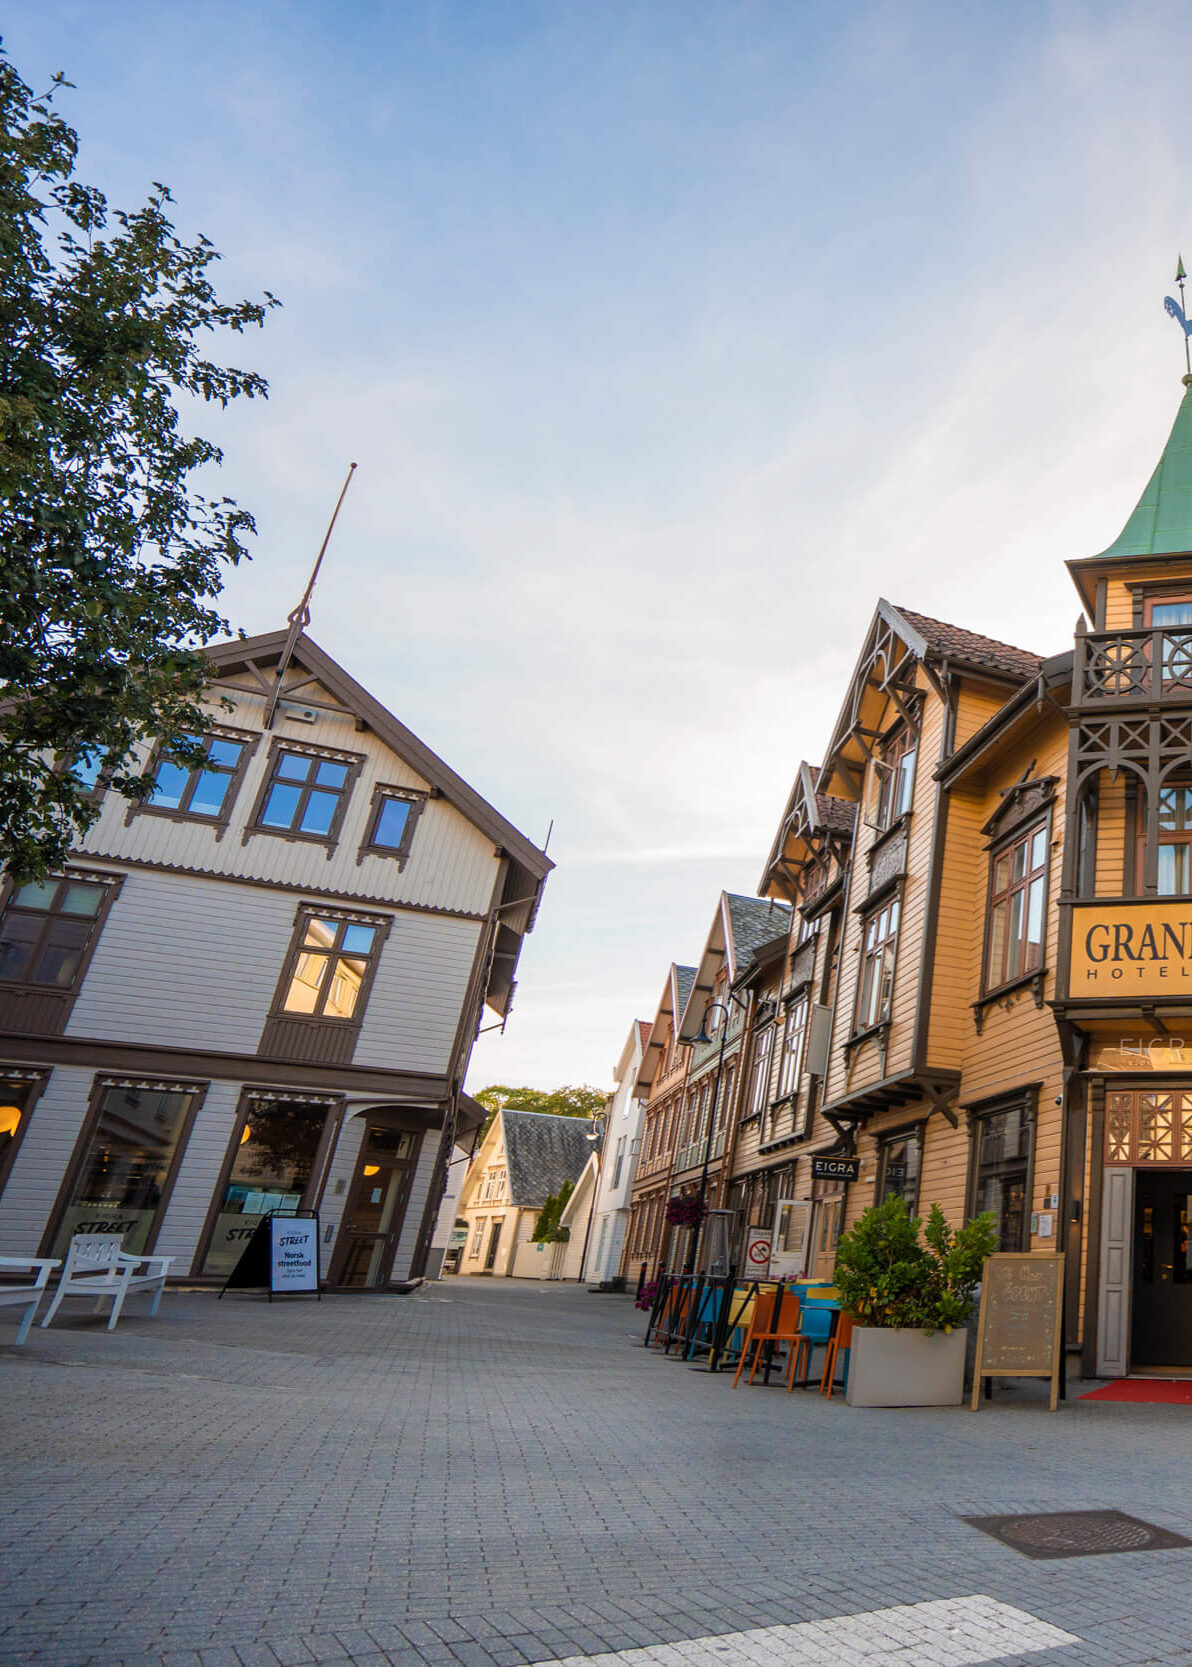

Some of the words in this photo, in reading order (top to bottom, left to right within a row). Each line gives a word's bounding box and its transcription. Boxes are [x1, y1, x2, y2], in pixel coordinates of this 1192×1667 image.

[815, 1161, 855, 1174] EIGRA
[73, 1220, 139, 1235] STREET
[225, 1227, 258, 1241] STR
[279, 1235, 309, 1247] STREET
[284, 1251, 304, 1259] Norsk
[277, 1259, 312, 1267] streetfood
